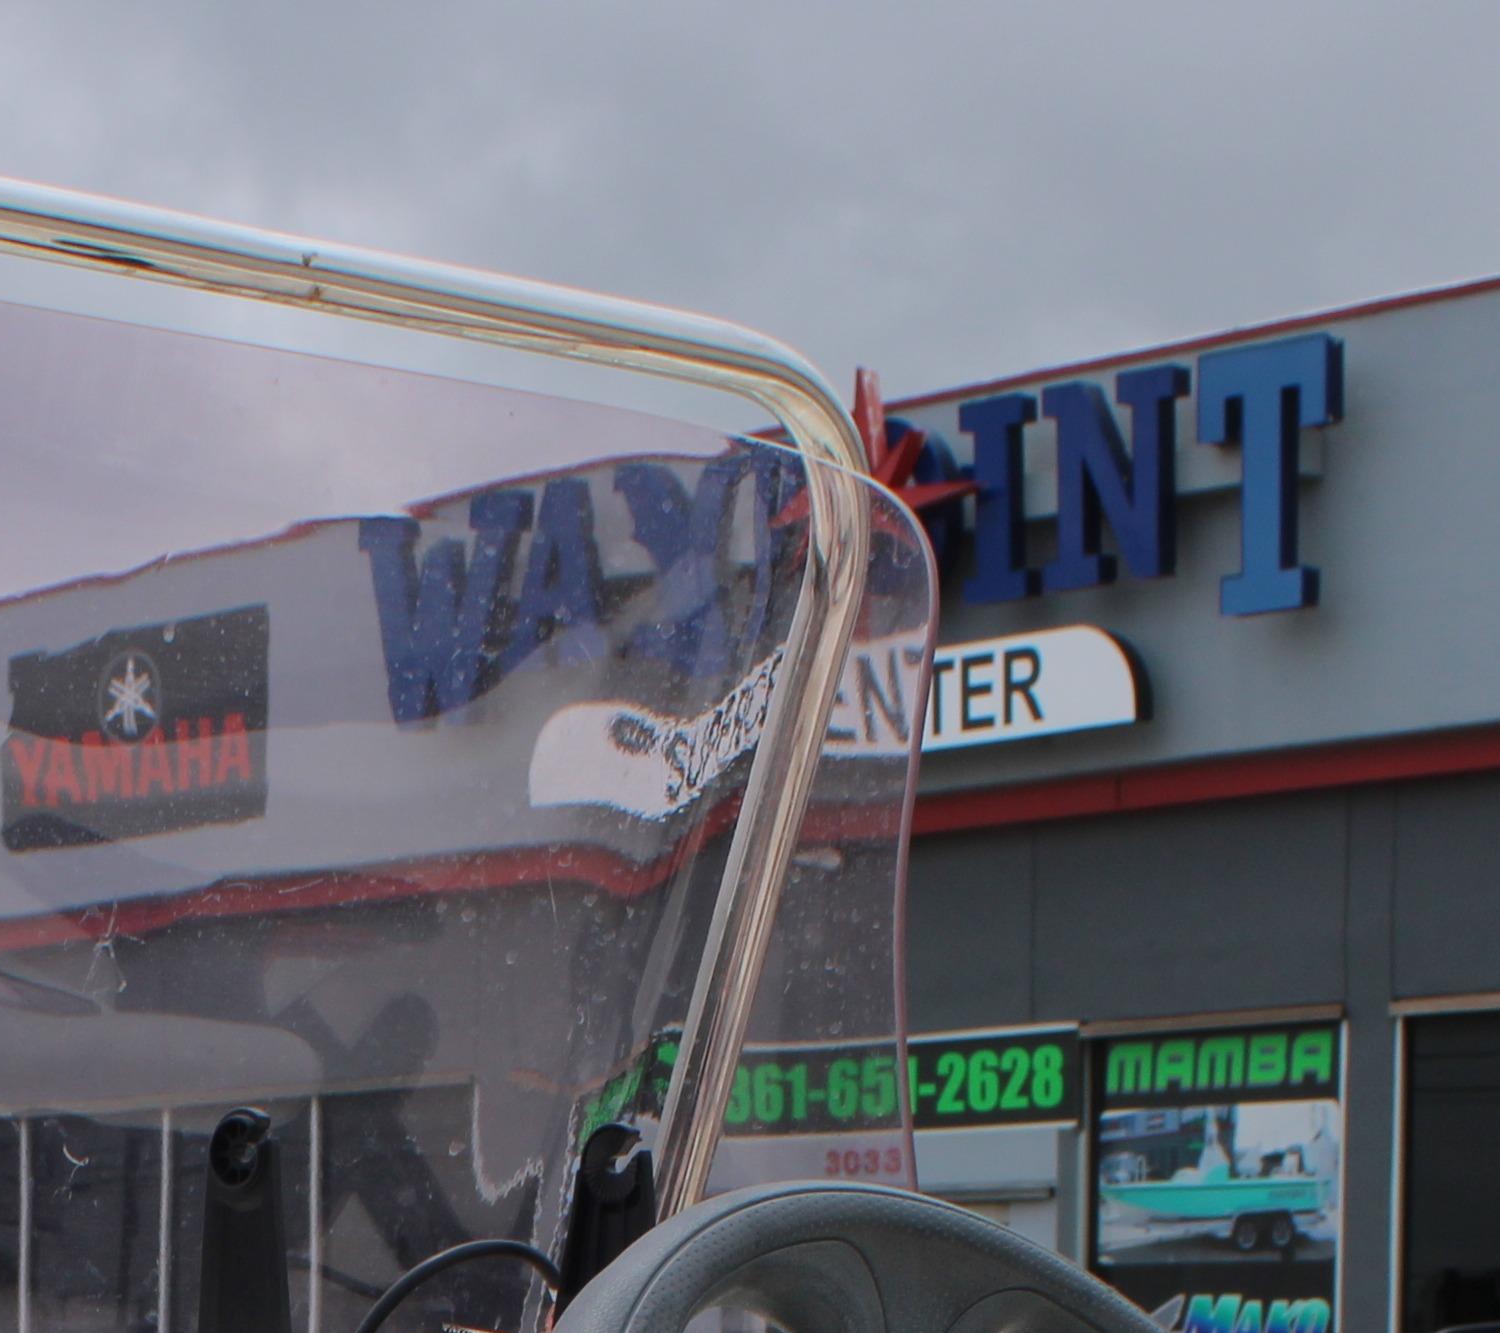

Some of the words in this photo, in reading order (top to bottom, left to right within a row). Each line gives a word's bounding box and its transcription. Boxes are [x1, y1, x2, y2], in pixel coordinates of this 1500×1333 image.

[8, 712, 250, 808] YAMAHA
[1105, 1029, 1333, 1095] MAMBA
[825, 1148, 901, 1176] 3033
